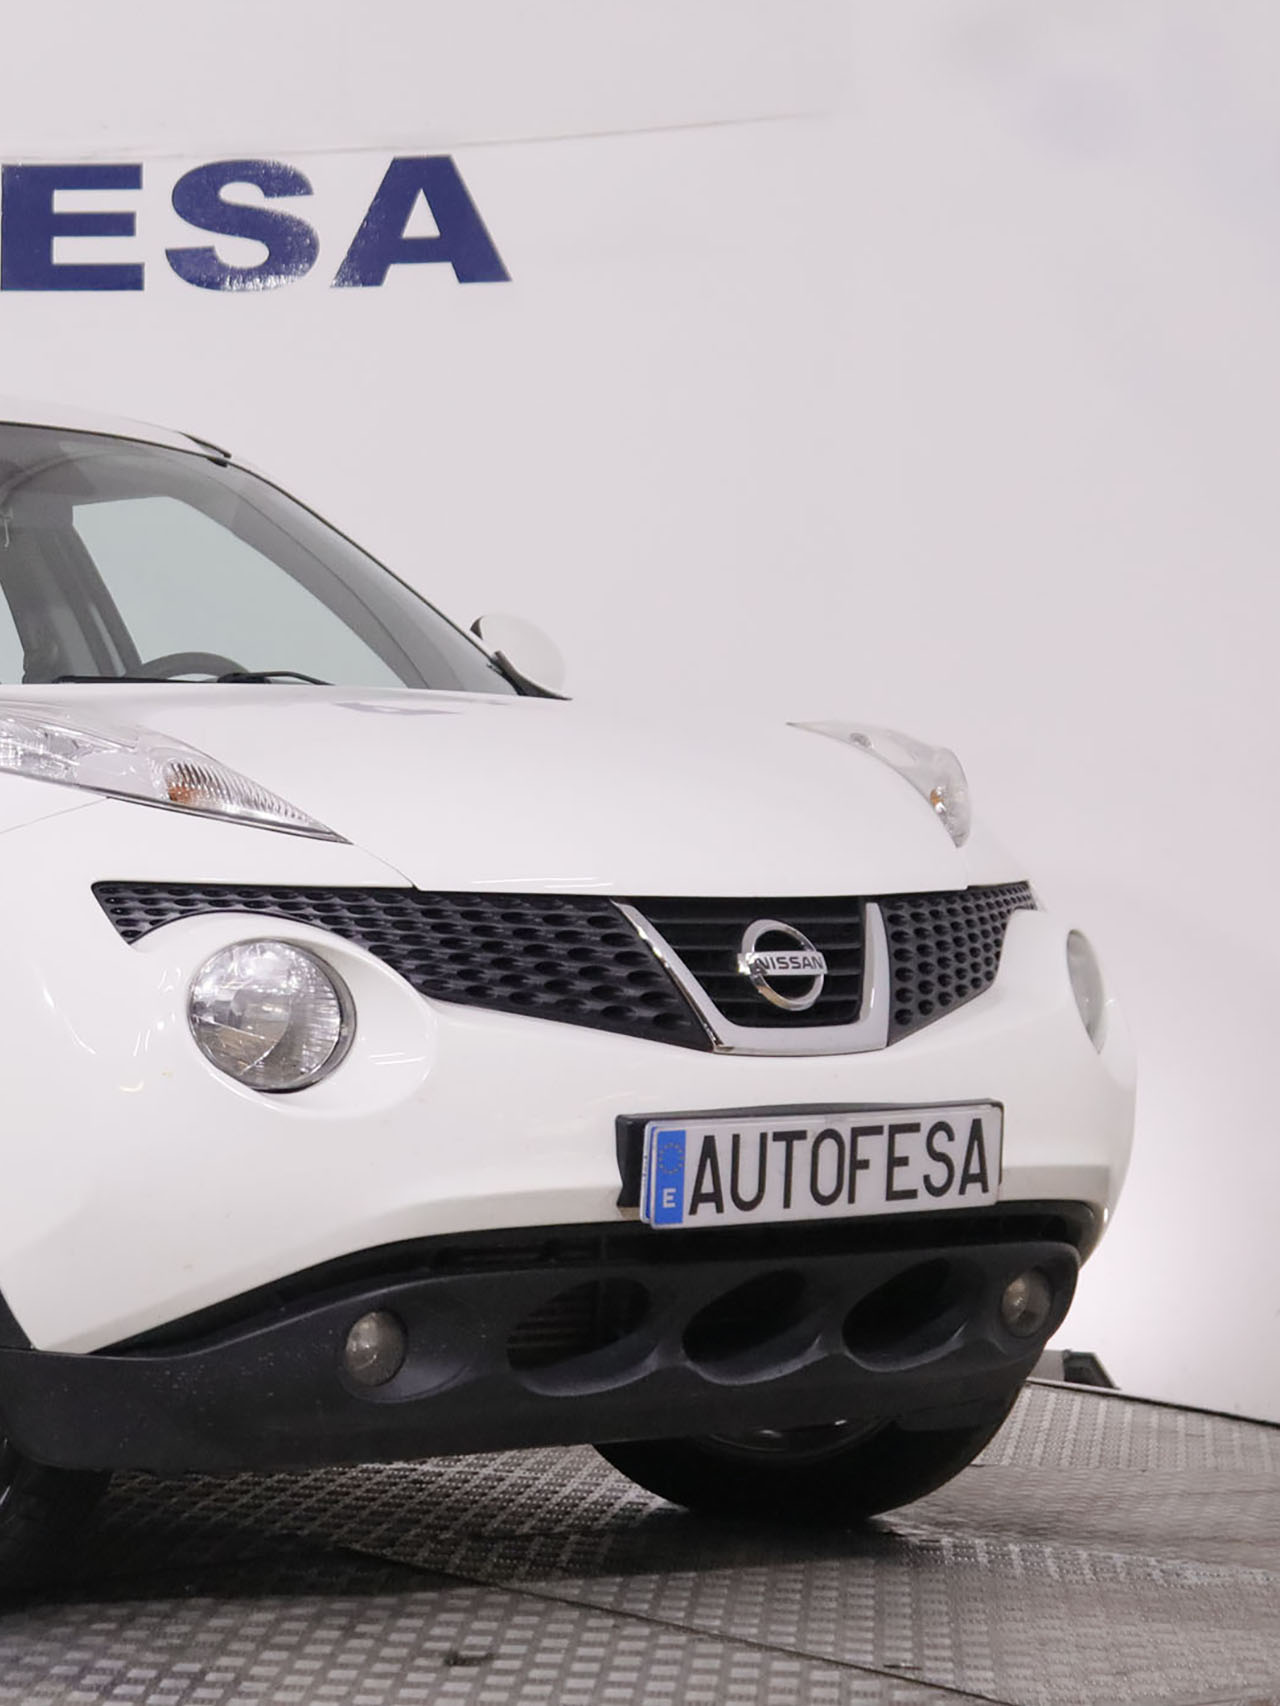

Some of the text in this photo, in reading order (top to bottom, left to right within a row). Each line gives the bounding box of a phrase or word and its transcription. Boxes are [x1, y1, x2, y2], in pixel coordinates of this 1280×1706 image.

[754, 955, 824, 970] NISSAN
[662, 1118, 989, 1216] E AUTOFESA
